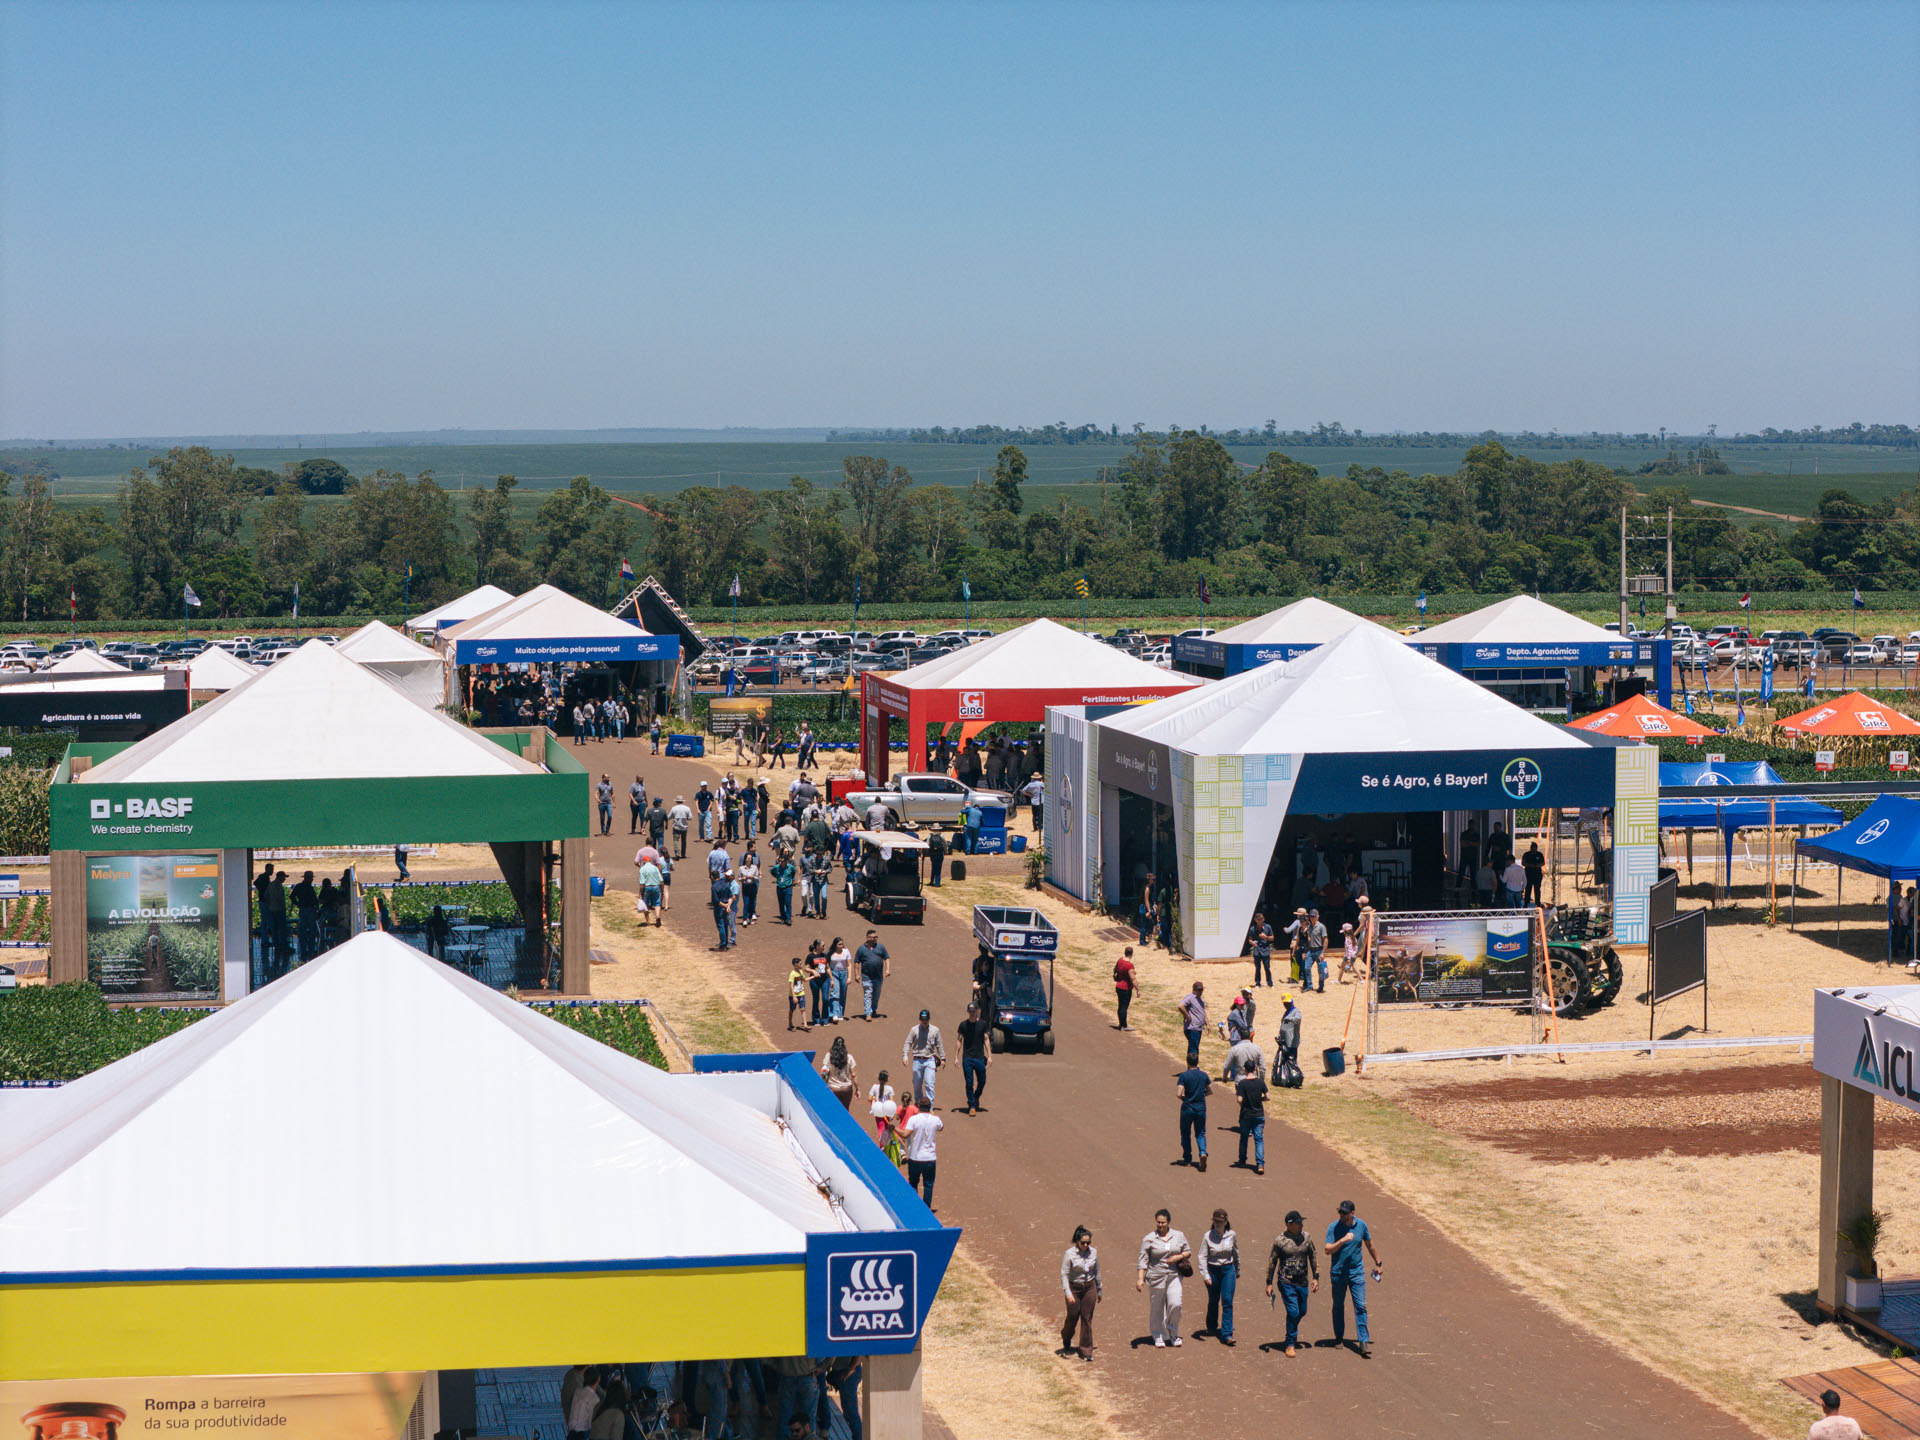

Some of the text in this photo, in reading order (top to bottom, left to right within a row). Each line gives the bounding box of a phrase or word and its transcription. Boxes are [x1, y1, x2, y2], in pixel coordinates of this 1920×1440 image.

[537, 646, 568, 654] obrigado
[570, 646, 584, 654] pela
[586, 645, 620, 653] presença!
[1506, 647, 1580, 656] Depto. Agronômico:
[42, 714, 85, 722] Agricultura
[1362, 773, 1488, 789] Se é Agro, é Bayer!
[127, 798, 192, 818] BASF
[92, 824, 193, 835] We create chemistry
[92, 869, 130, 882] Melyra
[109, 905, 200, 919] A EVOLUÇÃO
[840, 1313, 904, 1330] YARA
[145, 1397, 266, 1412] Rompa a barreira
[144, 1414, 287, 1431] da sua produtividade
